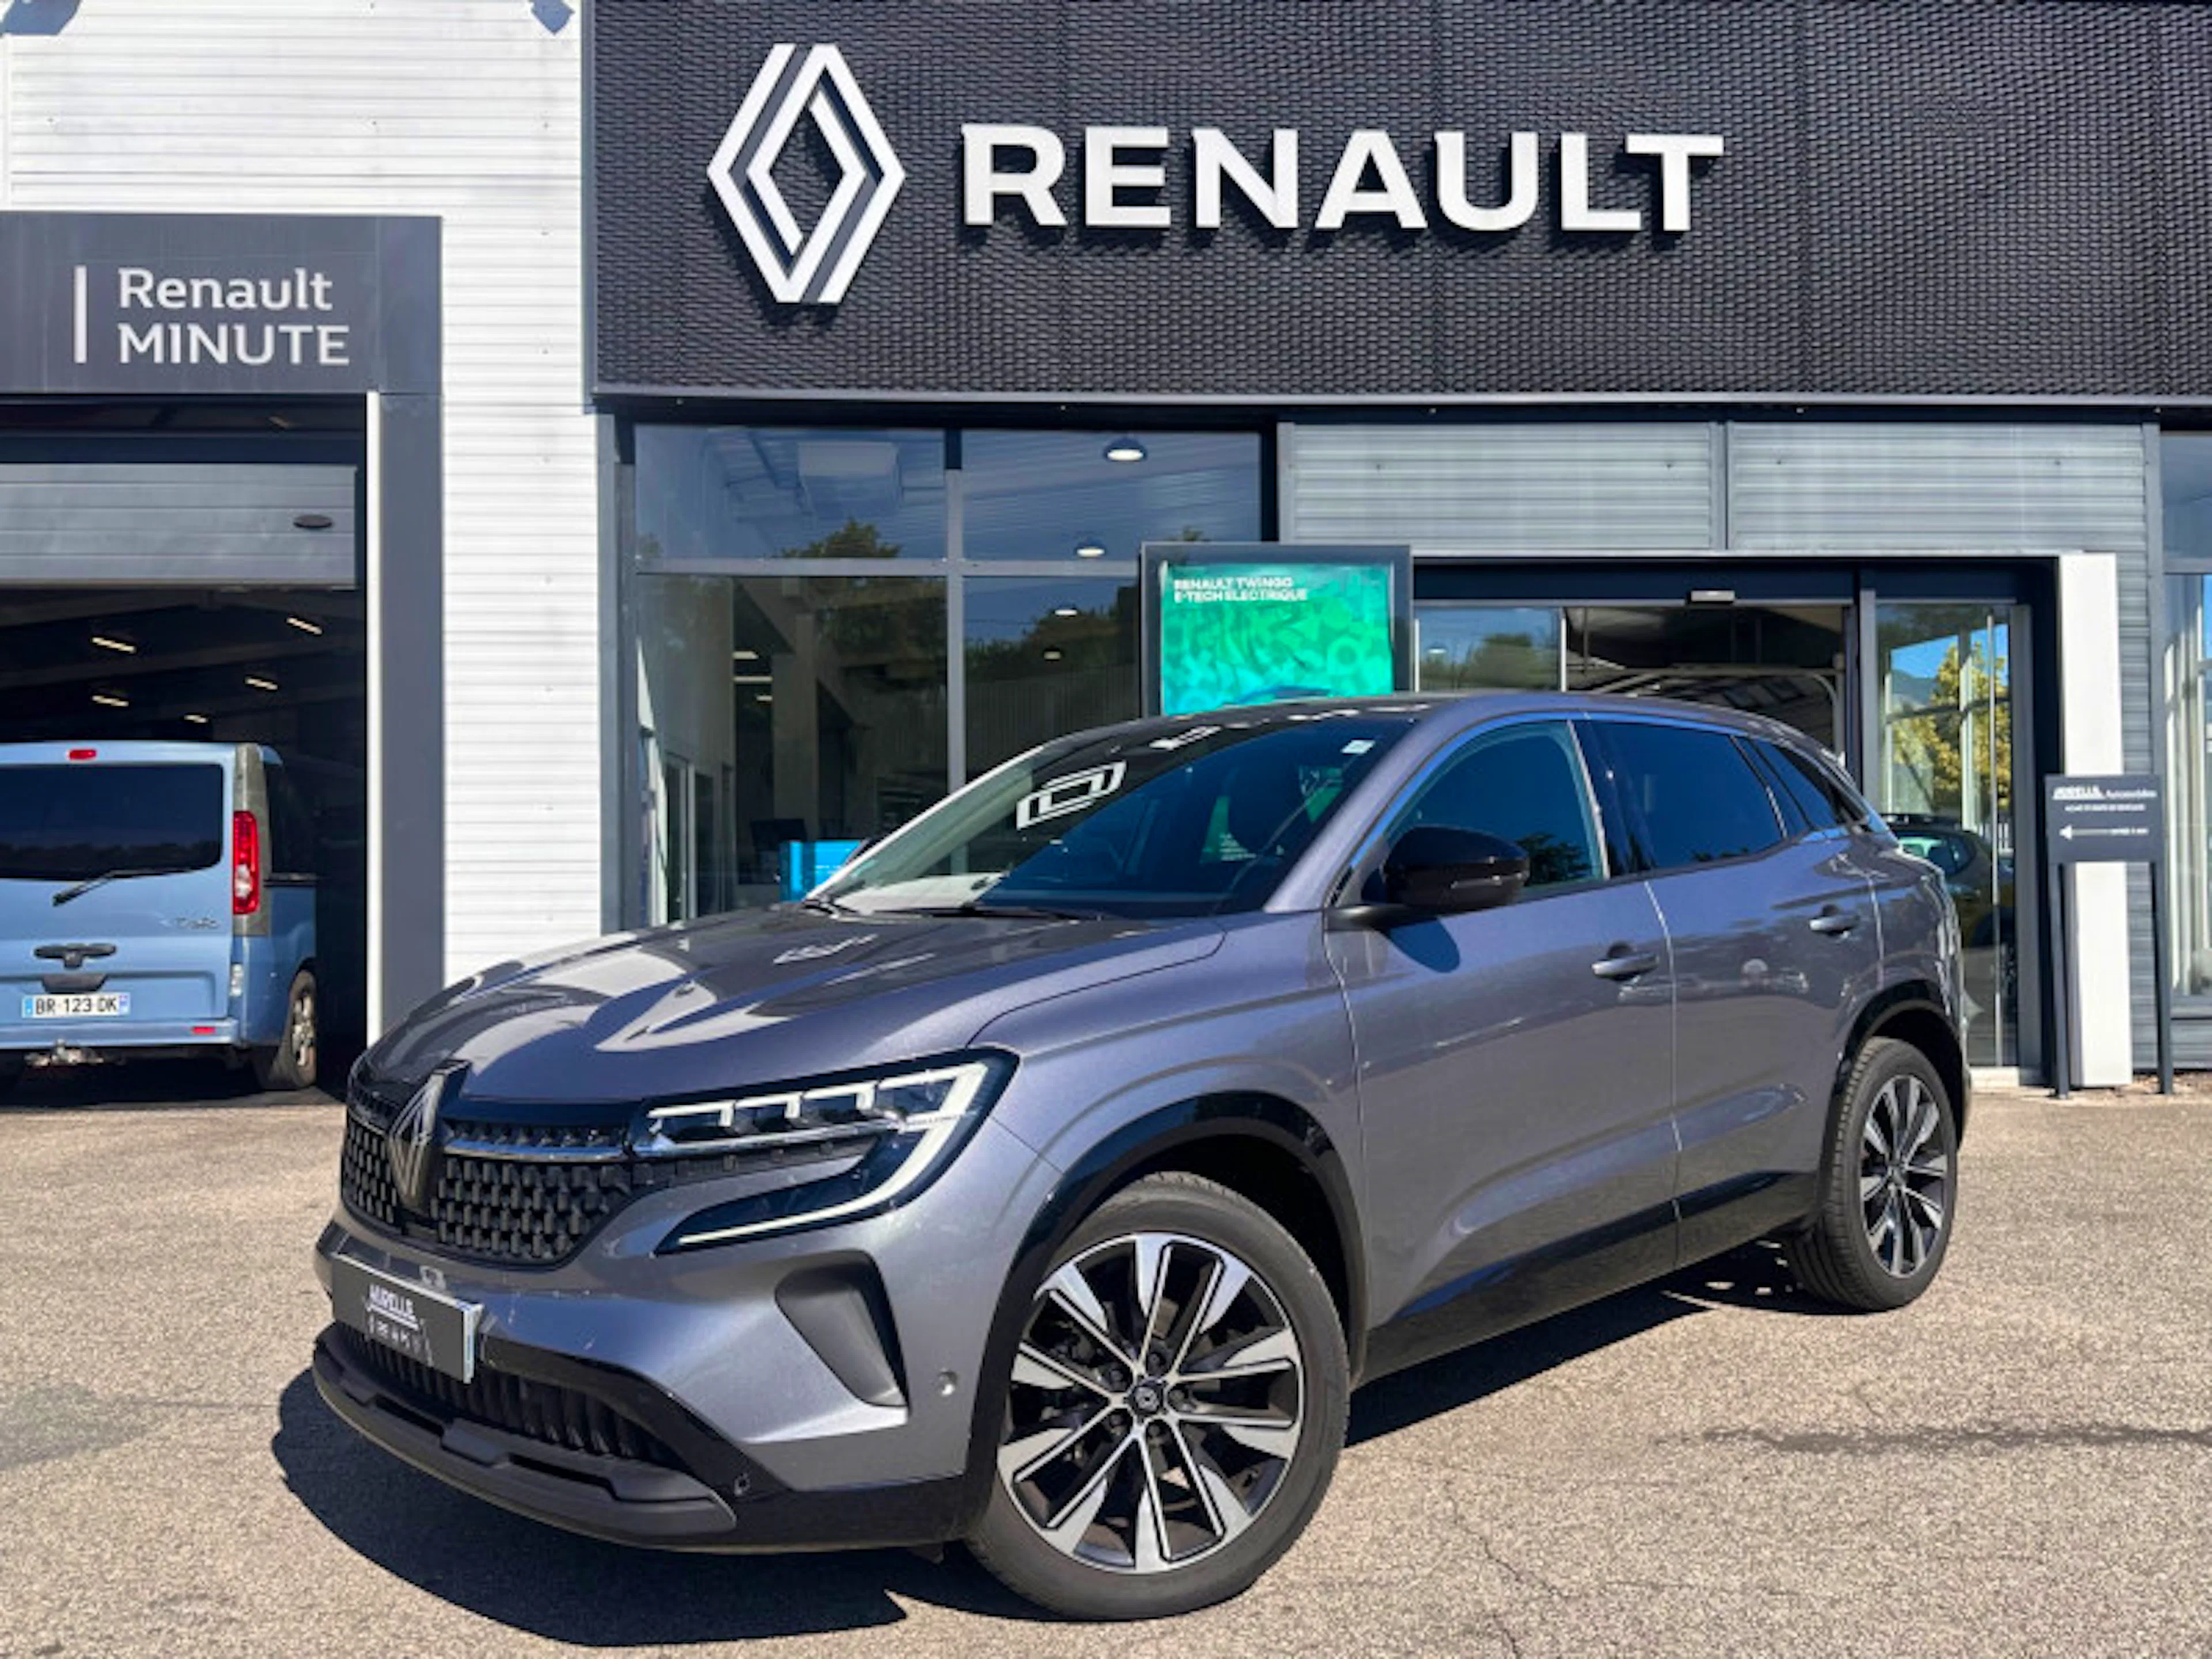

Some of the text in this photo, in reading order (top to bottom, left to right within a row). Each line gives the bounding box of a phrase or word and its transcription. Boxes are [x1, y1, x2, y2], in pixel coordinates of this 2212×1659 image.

[961, 123, 1724, 232] RENAULT
[118, 267, 333, 310] Renault
[118, 324, 350, 365] MINUTE
[36, 997, 118, 1016] BR 123 DK
